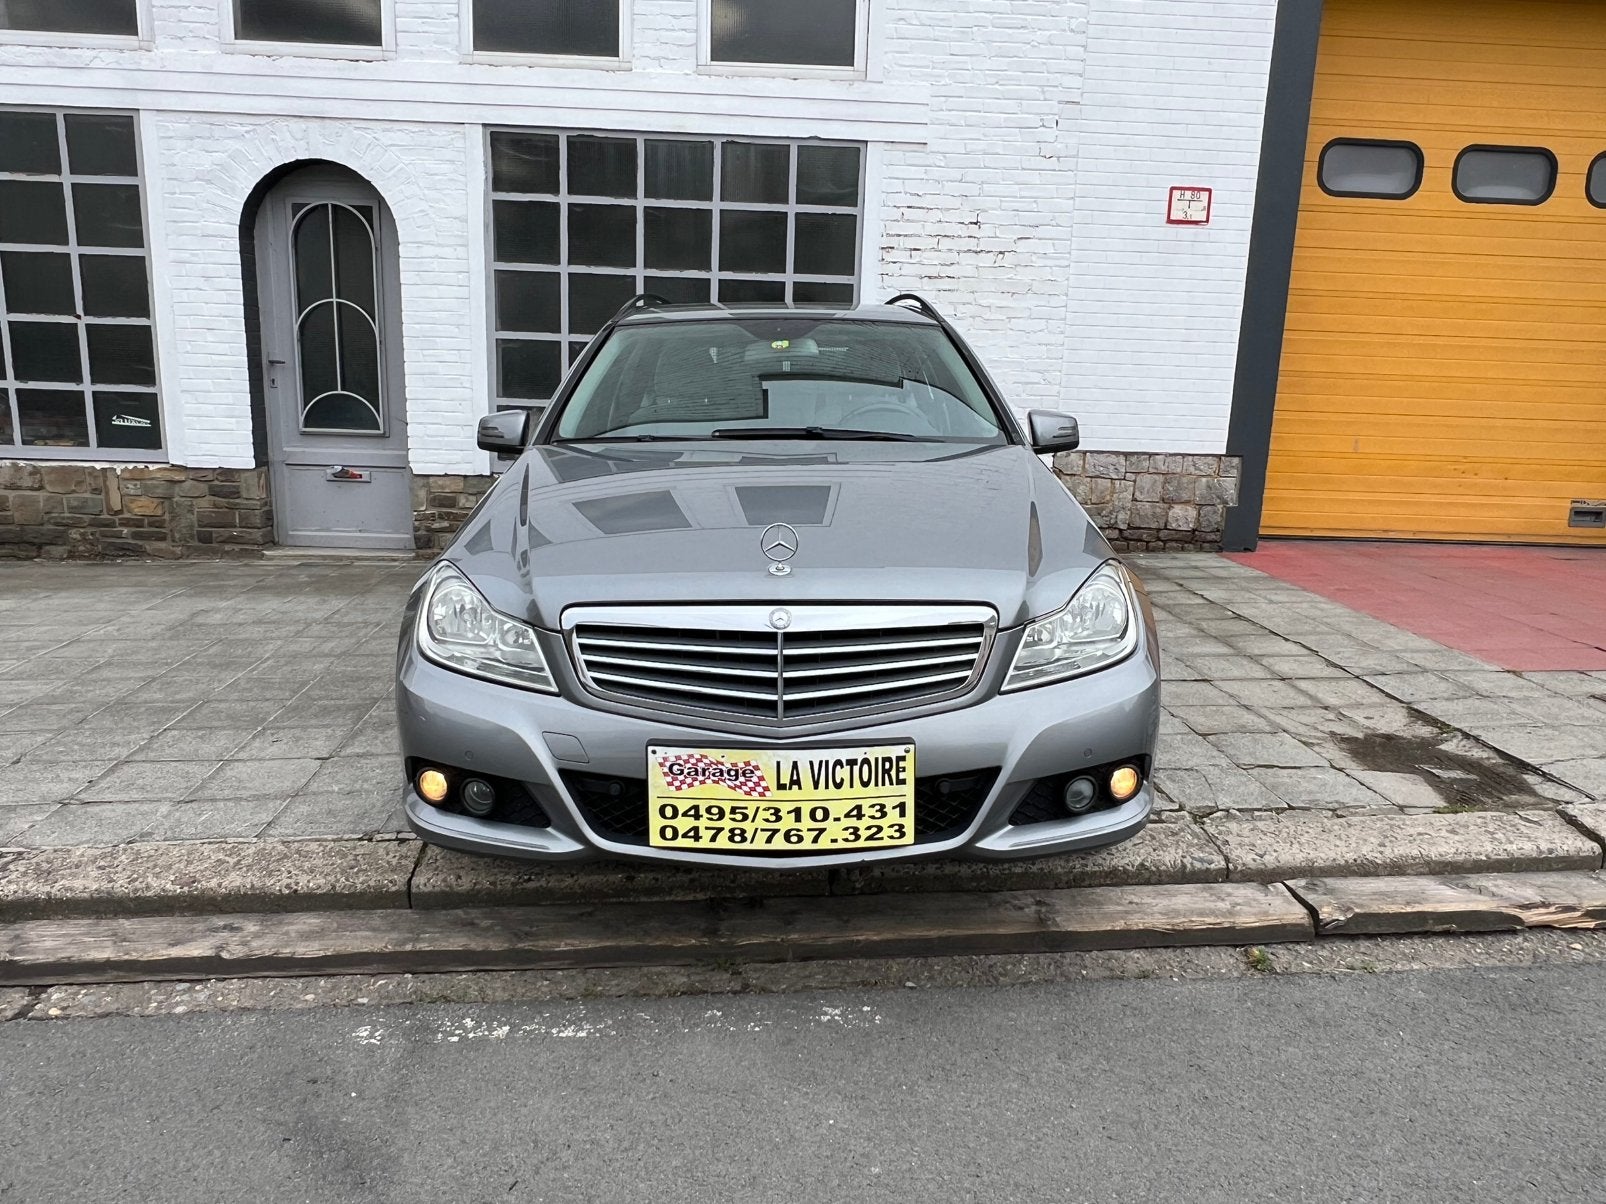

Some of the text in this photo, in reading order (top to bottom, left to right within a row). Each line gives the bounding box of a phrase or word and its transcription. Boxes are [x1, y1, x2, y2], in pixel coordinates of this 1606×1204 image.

[1179, 190, 1186, 199] H
[668, 762, 755, 782] Garage
[775, 755, 907, 791] LA VICTOIRE
[658, 803, 907, 824] 0495/310.431
[658, 824, 907, 844] 0478/767.323
